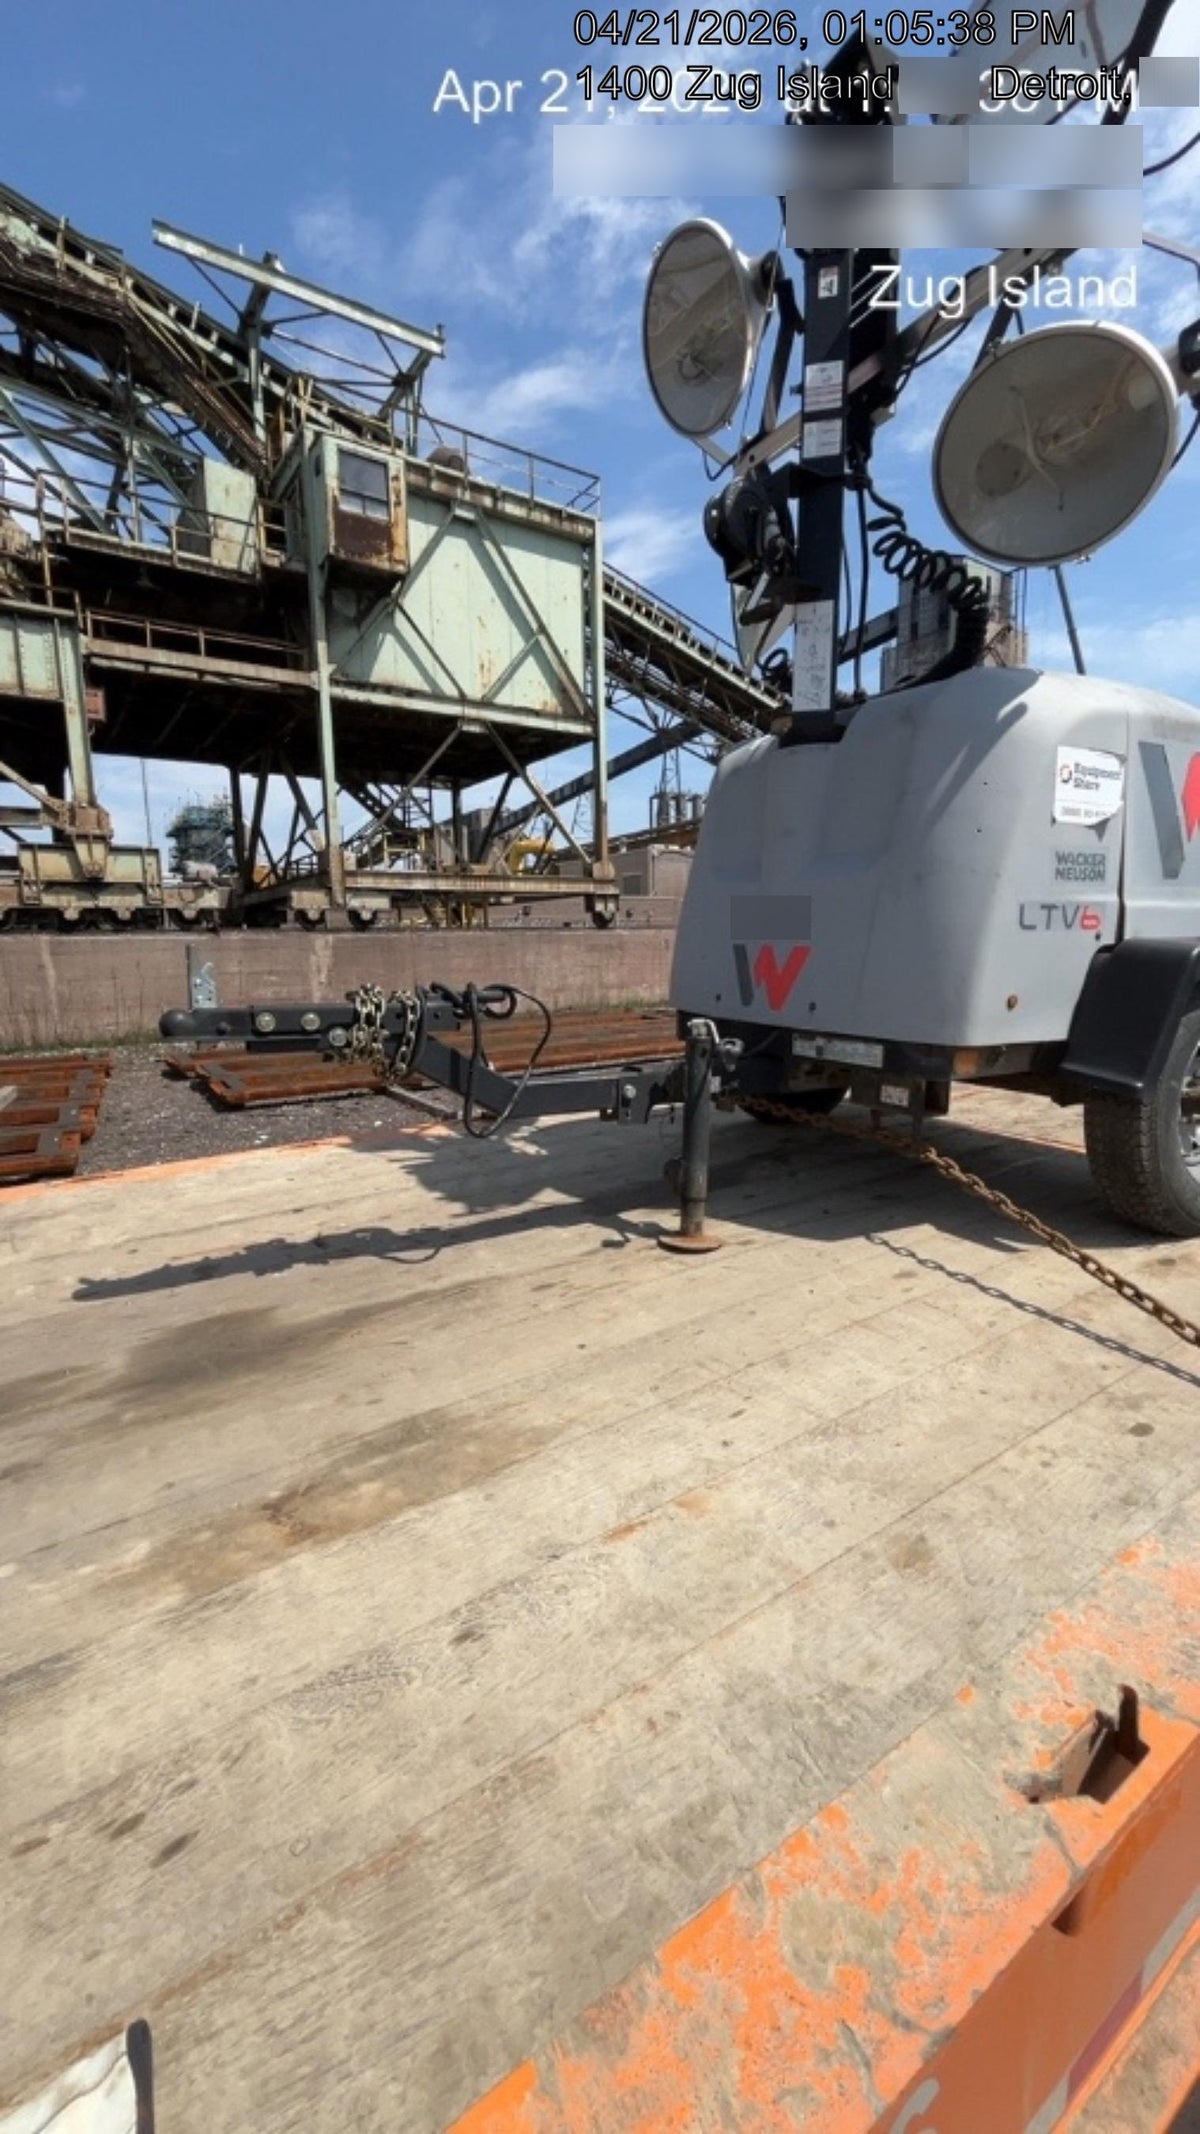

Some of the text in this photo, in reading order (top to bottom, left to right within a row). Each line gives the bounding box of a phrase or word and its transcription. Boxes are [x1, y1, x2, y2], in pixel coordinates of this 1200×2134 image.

[1055, 851, 1105, 866] WACKER
[1055, 866, 1105, 881] NEUSON
[1019, 903, 1101, 930] LTV6
